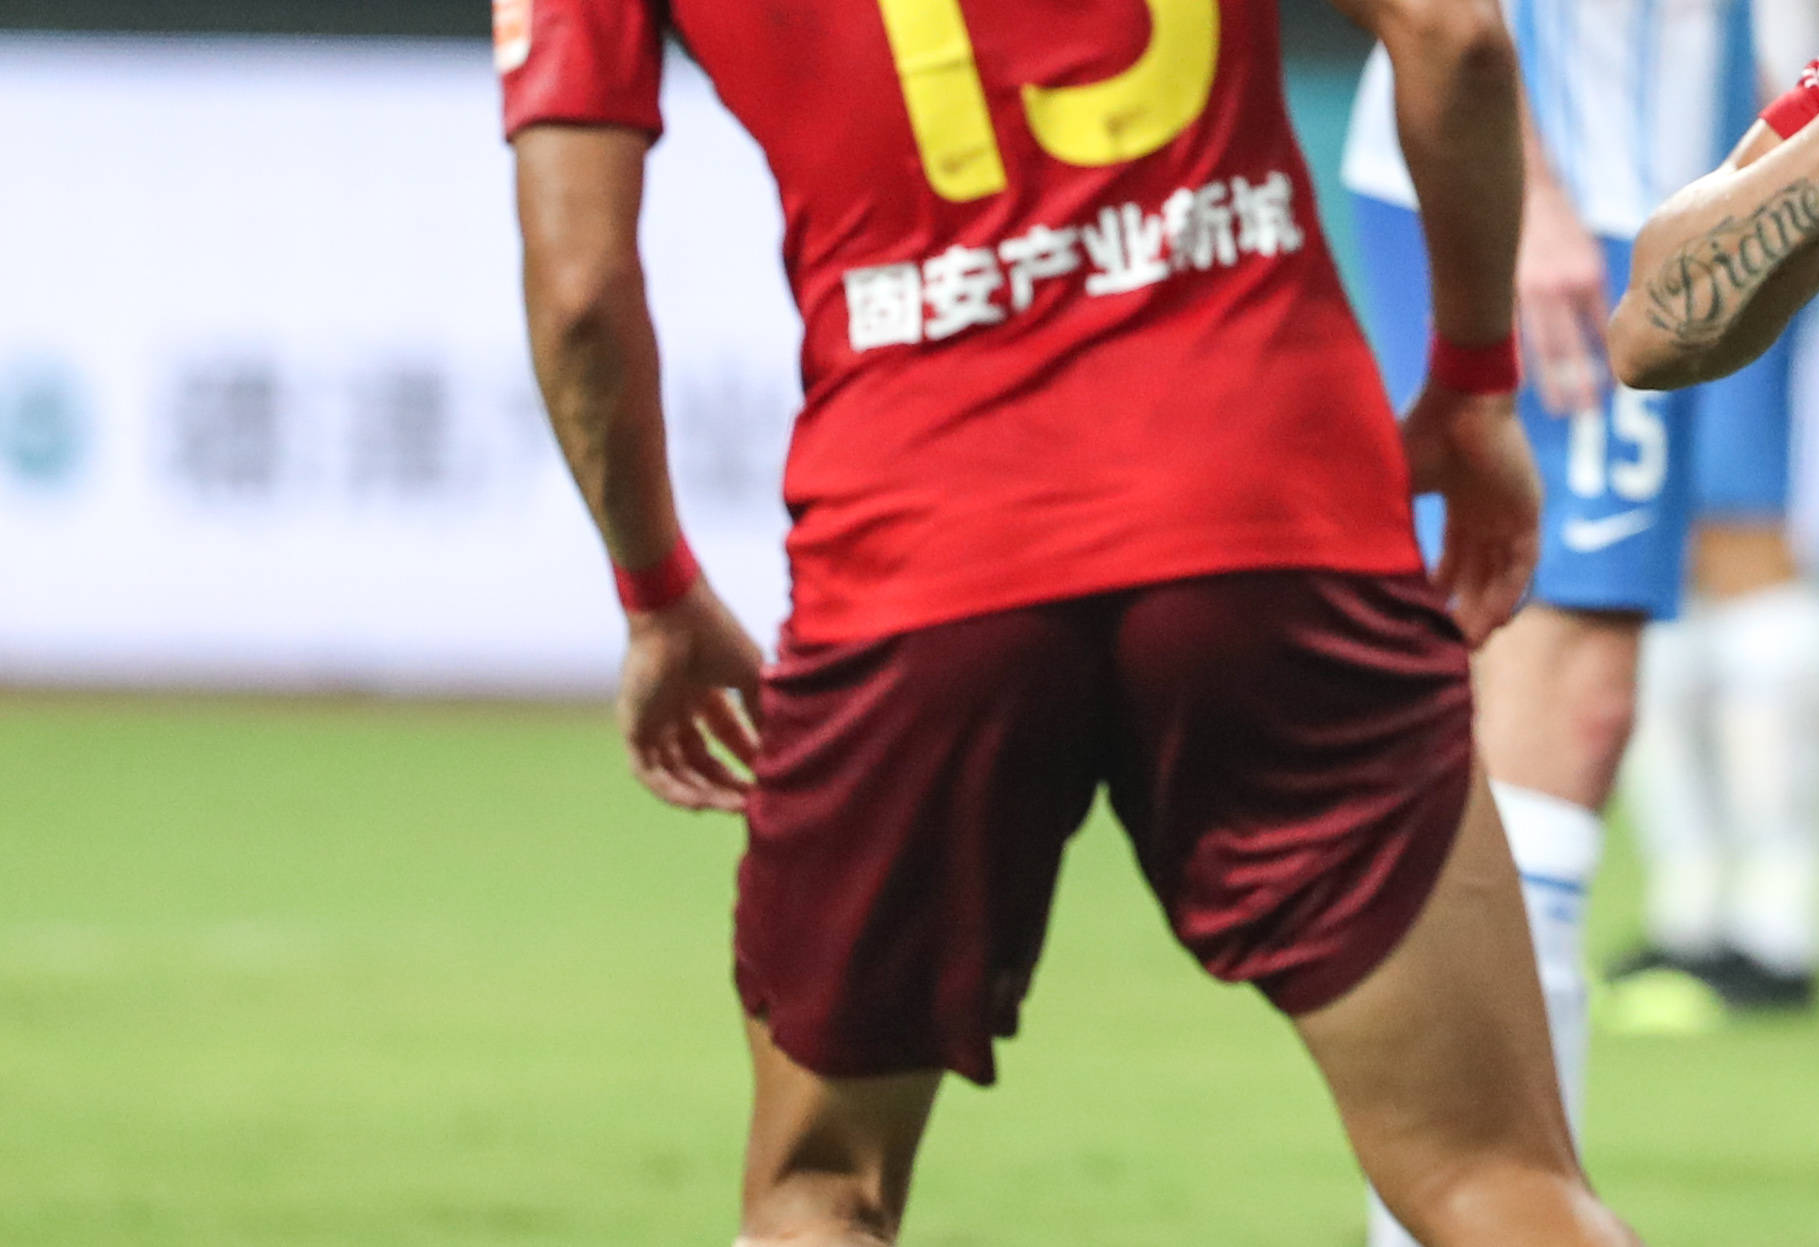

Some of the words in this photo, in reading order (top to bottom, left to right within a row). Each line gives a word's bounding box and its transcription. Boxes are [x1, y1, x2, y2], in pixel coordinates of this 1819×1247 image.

[842, 170, 1304, 353] 固安产业新城
[1567, 383, 1669, 502] 15
